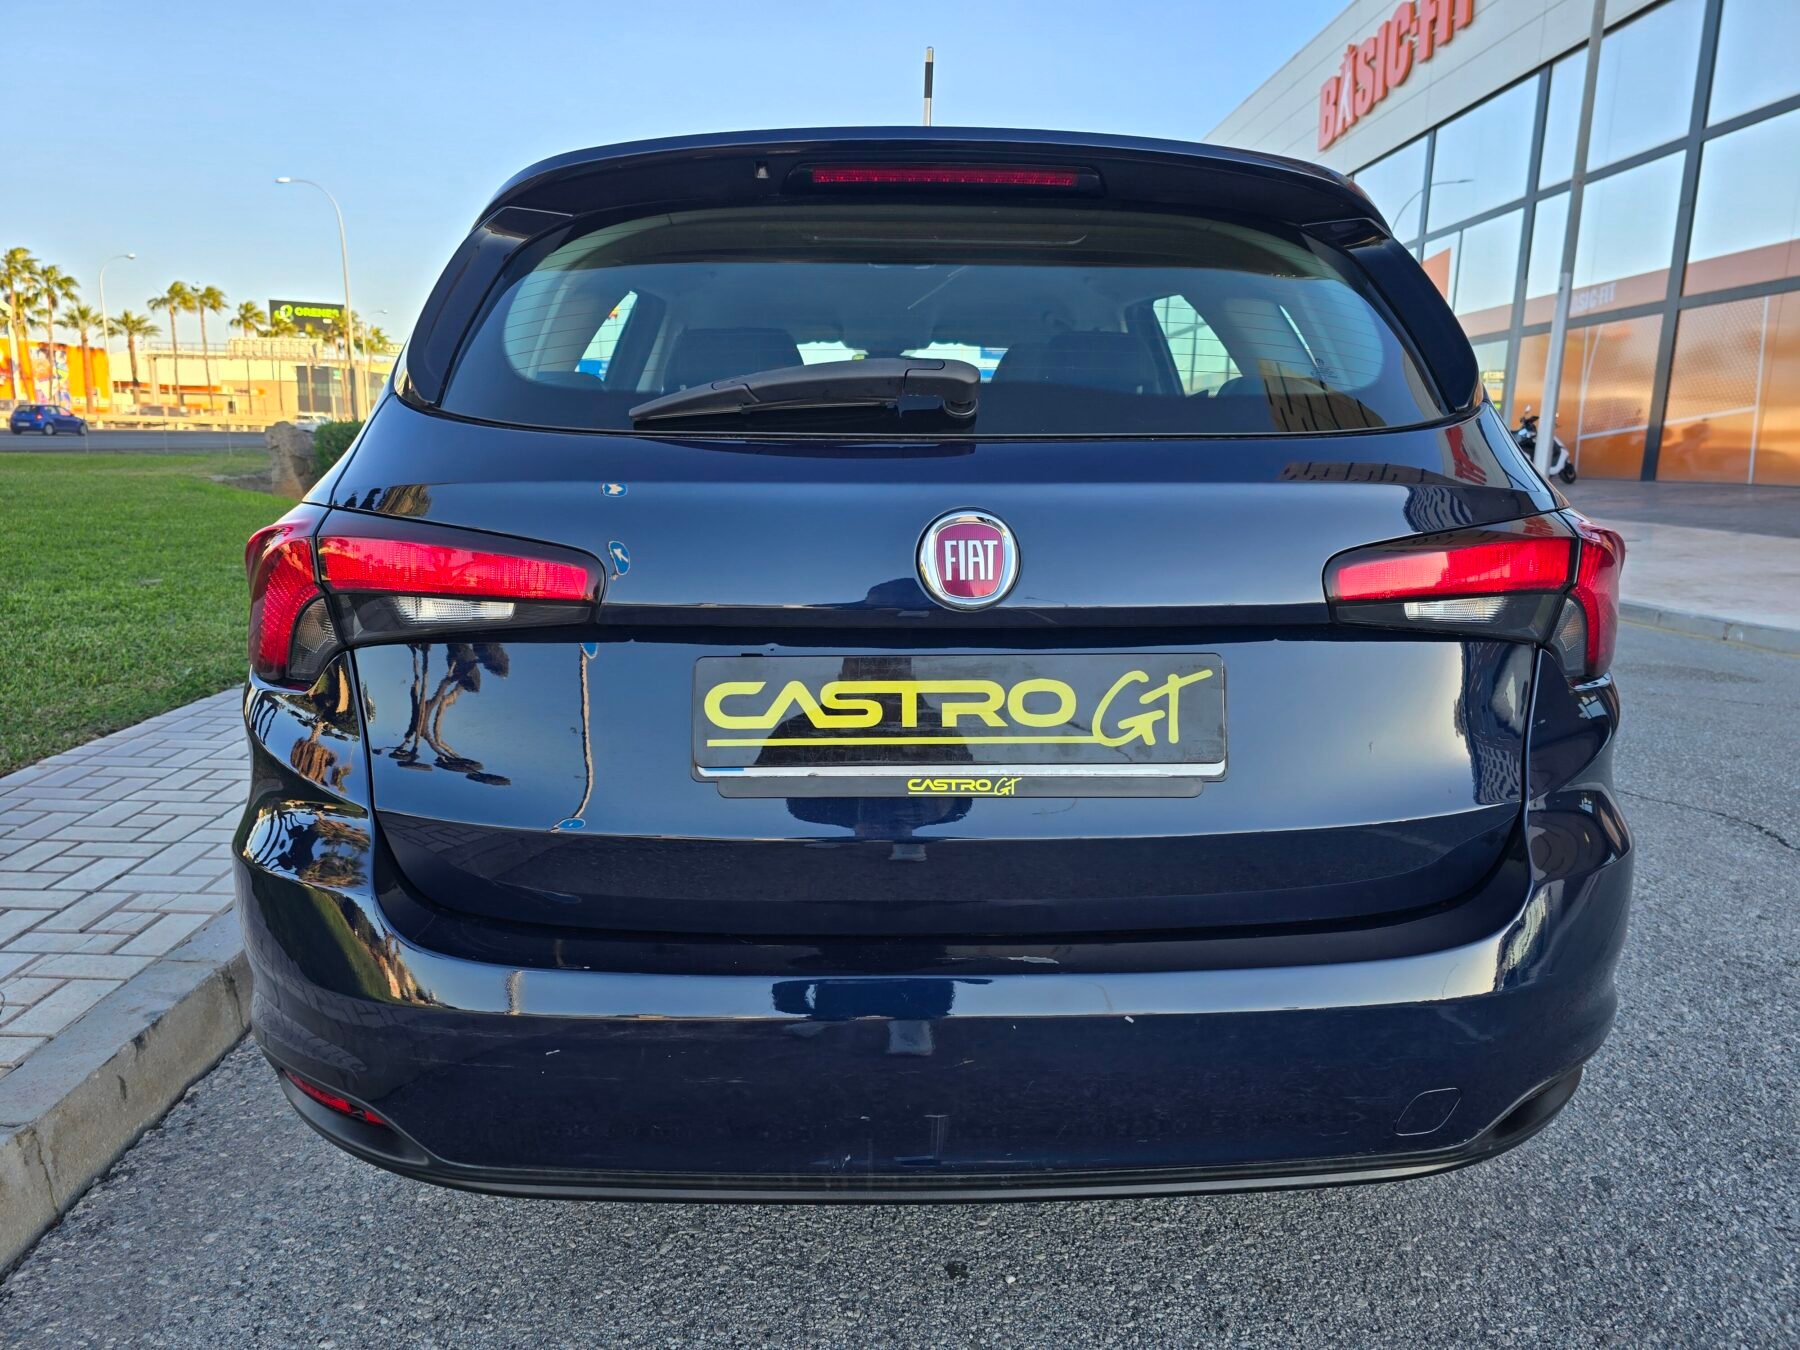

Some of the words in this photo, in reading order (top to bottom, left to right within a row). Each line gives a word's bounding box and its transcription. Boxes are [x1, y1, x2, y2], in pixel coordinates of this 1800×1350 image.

[944, 540, 998, 581] FIAT
[703, 678, 1077, 729] CASTRO
[1092, 670, 1214, 747] GT
[907, 778, 992, 791] CASTRO
[994, 777, 1023, 796] GT
